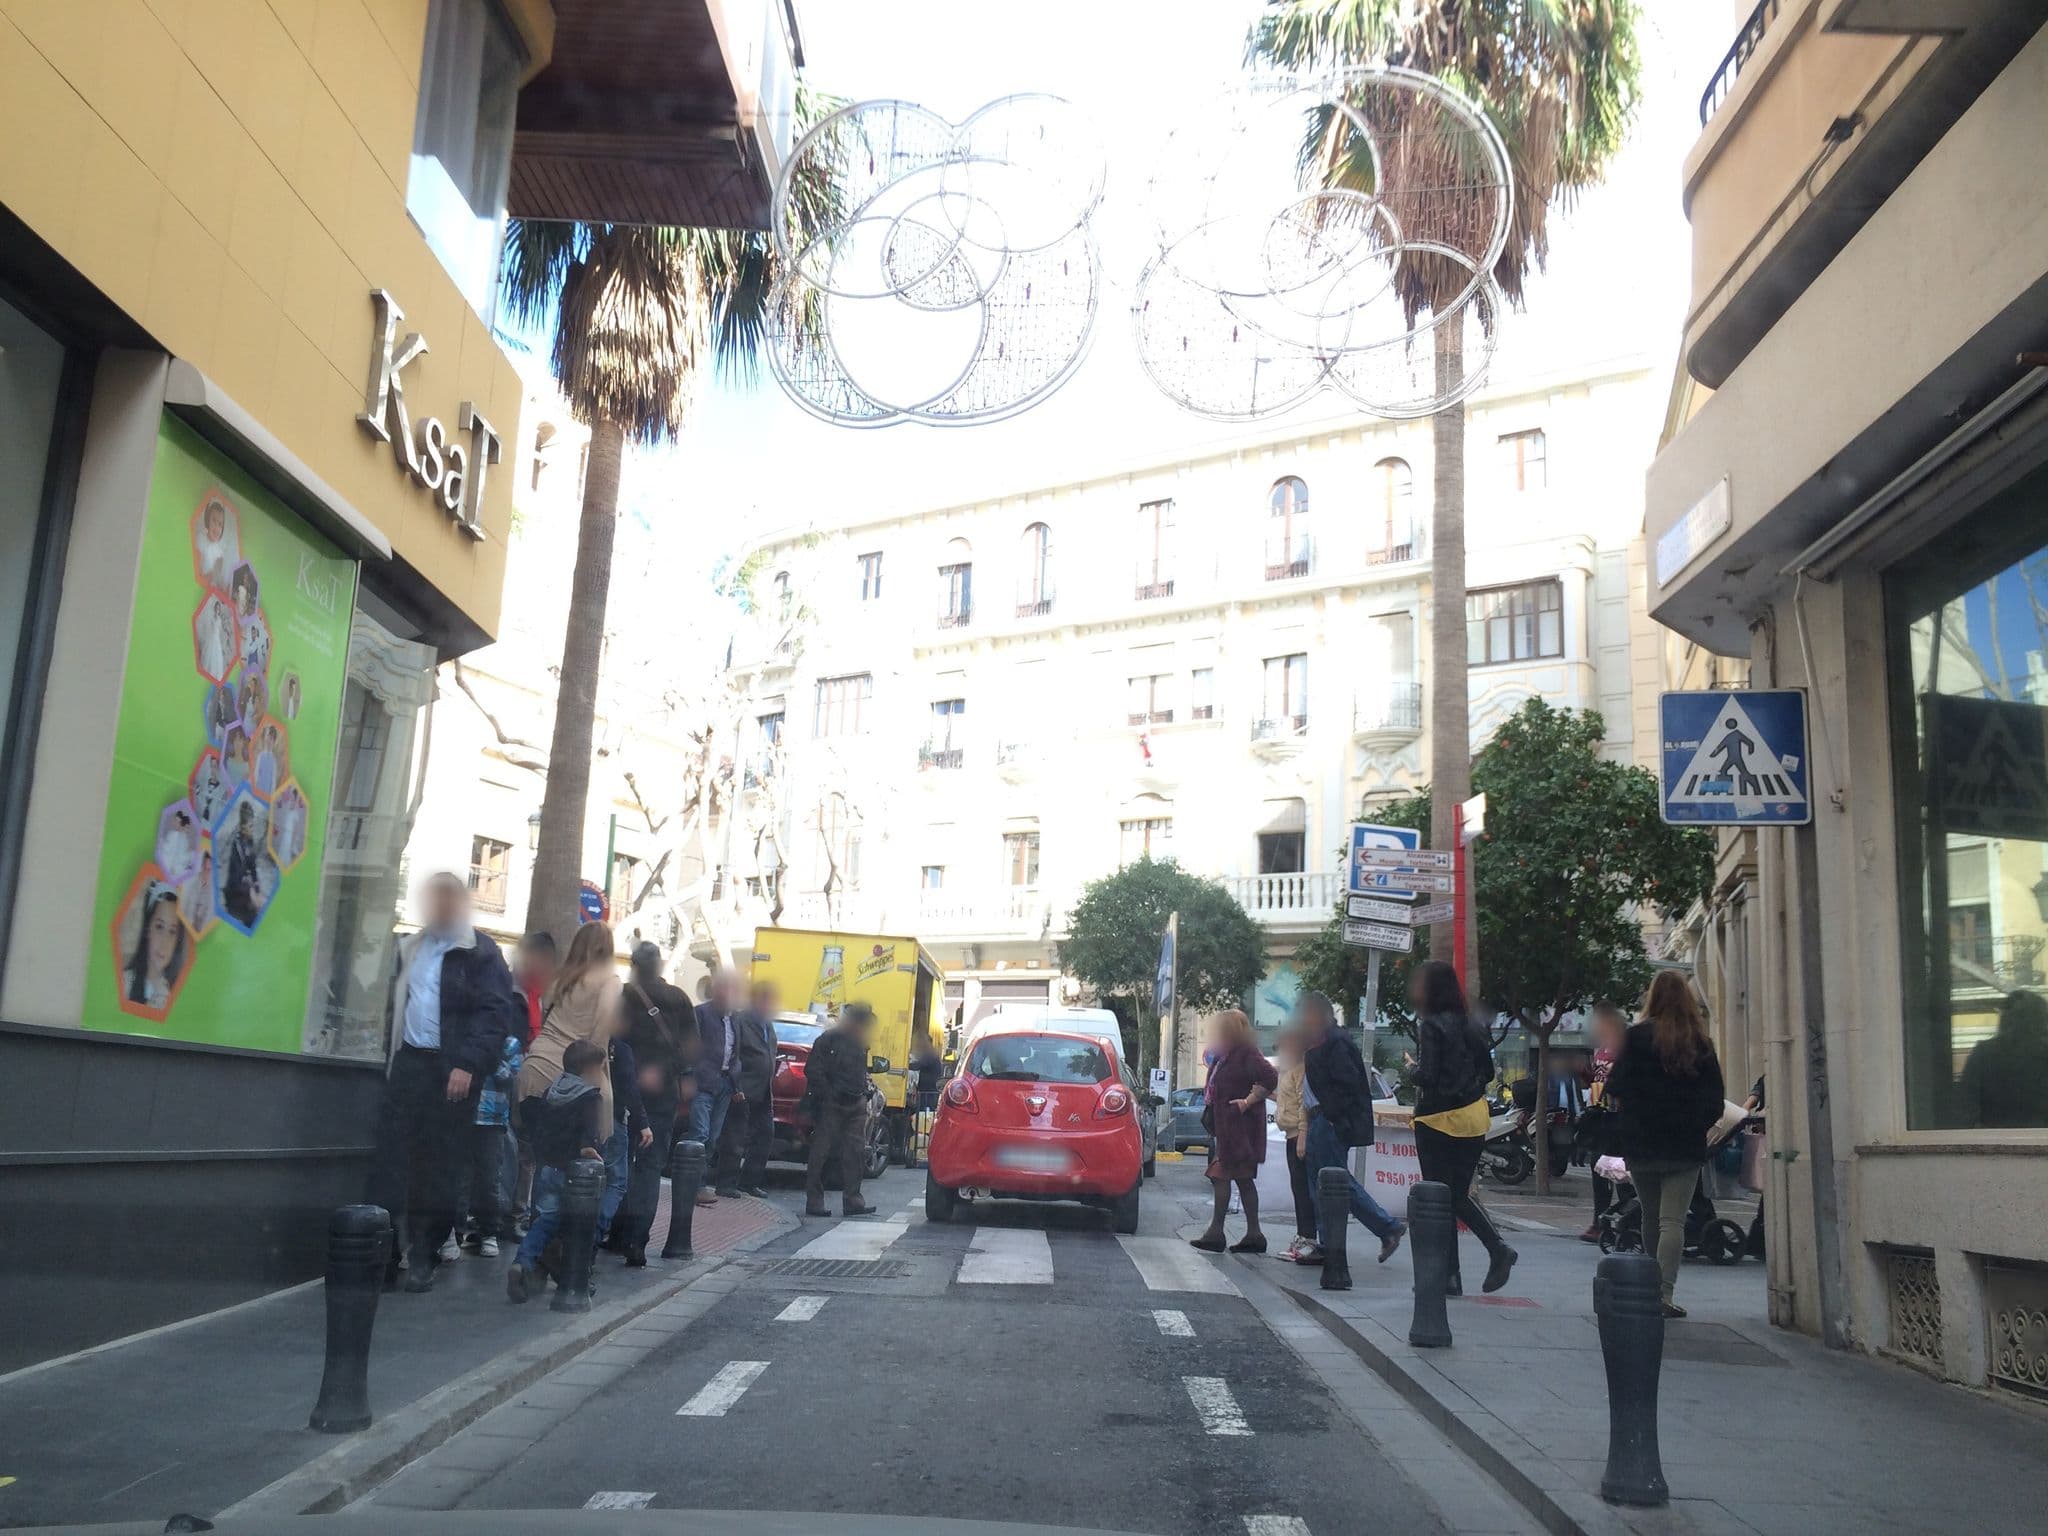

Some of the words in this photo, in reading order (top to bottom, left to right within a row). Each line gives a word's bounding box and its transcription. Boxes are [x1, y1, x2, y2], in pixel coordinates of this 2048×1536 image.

[356, 288, 501, 542] KsaT
[857, 954, 894, 975] Schweppes
[1375, 1142, 1389, 1155] EL
[1392, 1143, 1417, 1157] MOR
